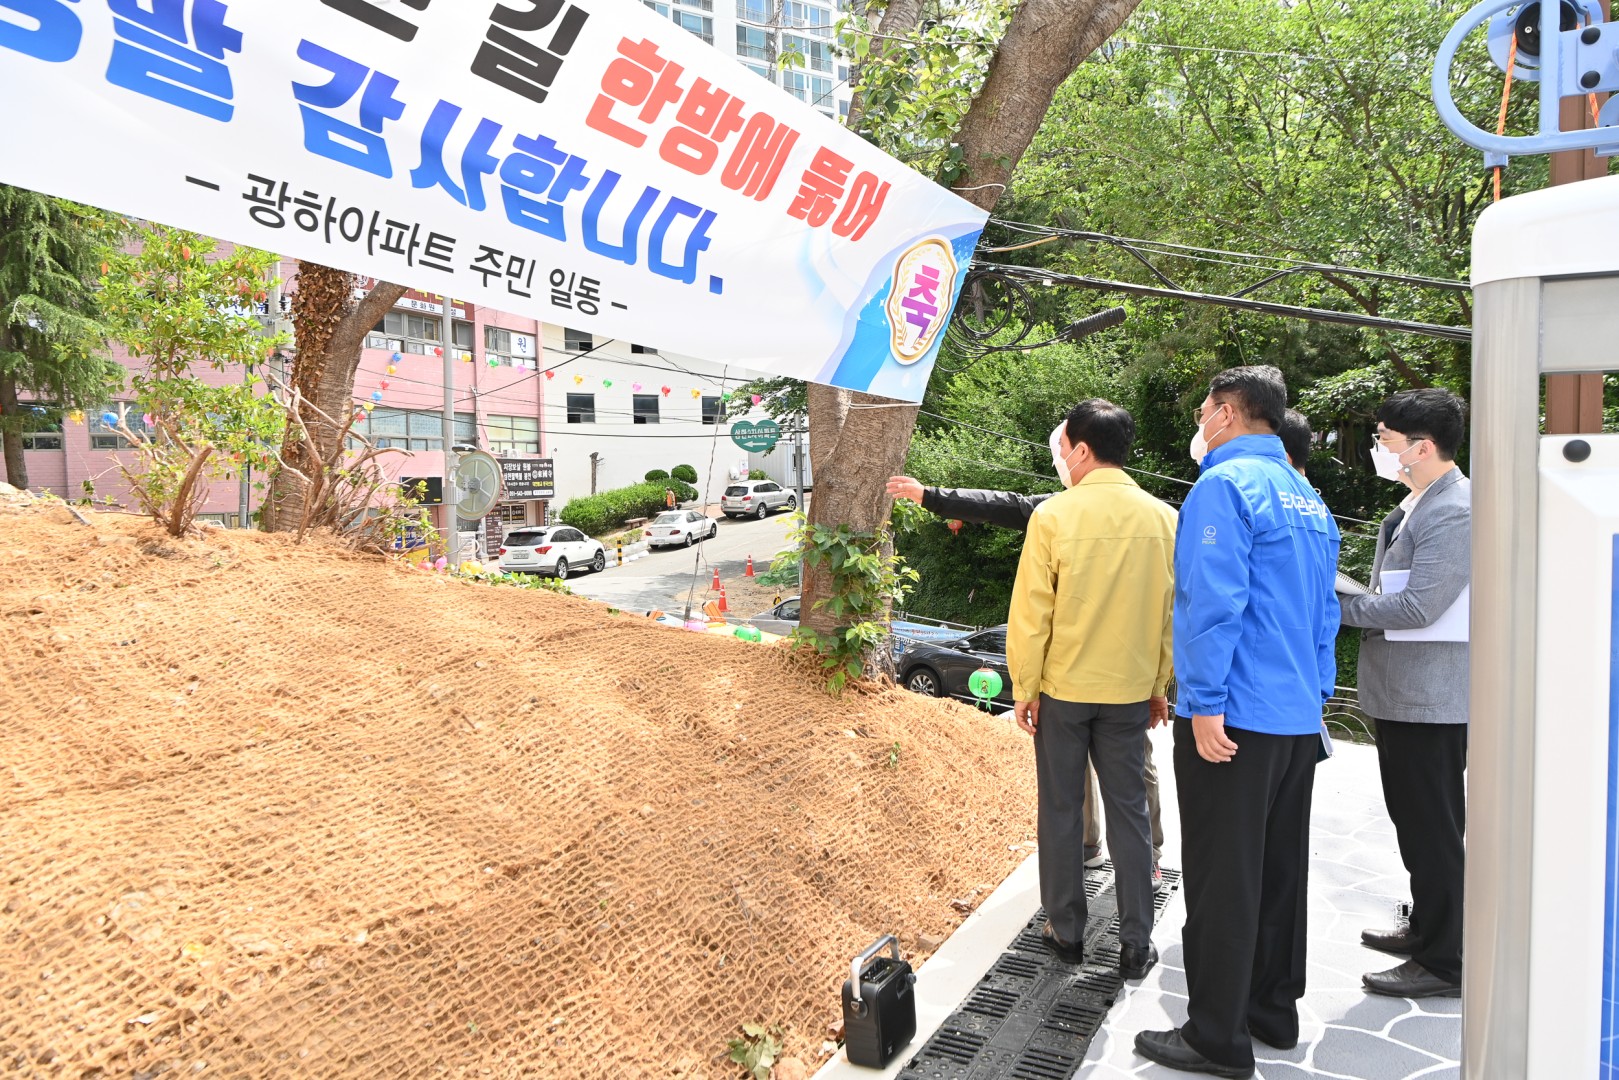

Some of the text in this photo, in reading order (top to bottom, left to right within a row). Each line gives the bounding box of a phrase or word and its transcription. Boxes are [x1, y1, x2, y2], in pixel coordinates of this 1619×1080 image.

[291, 38, 723, 295] 감사합니다.
[470, 0, 590, 104] 길
[585, 36, 800, 202] 한방에
[786, 145, 892, 242] 뚫어
[242, 172, 457, 274] 광하아파트
[469, 244, 537, 299] 주민
[549, 268, 601, 315] 일동
[901, 264, 940, 339] 축
